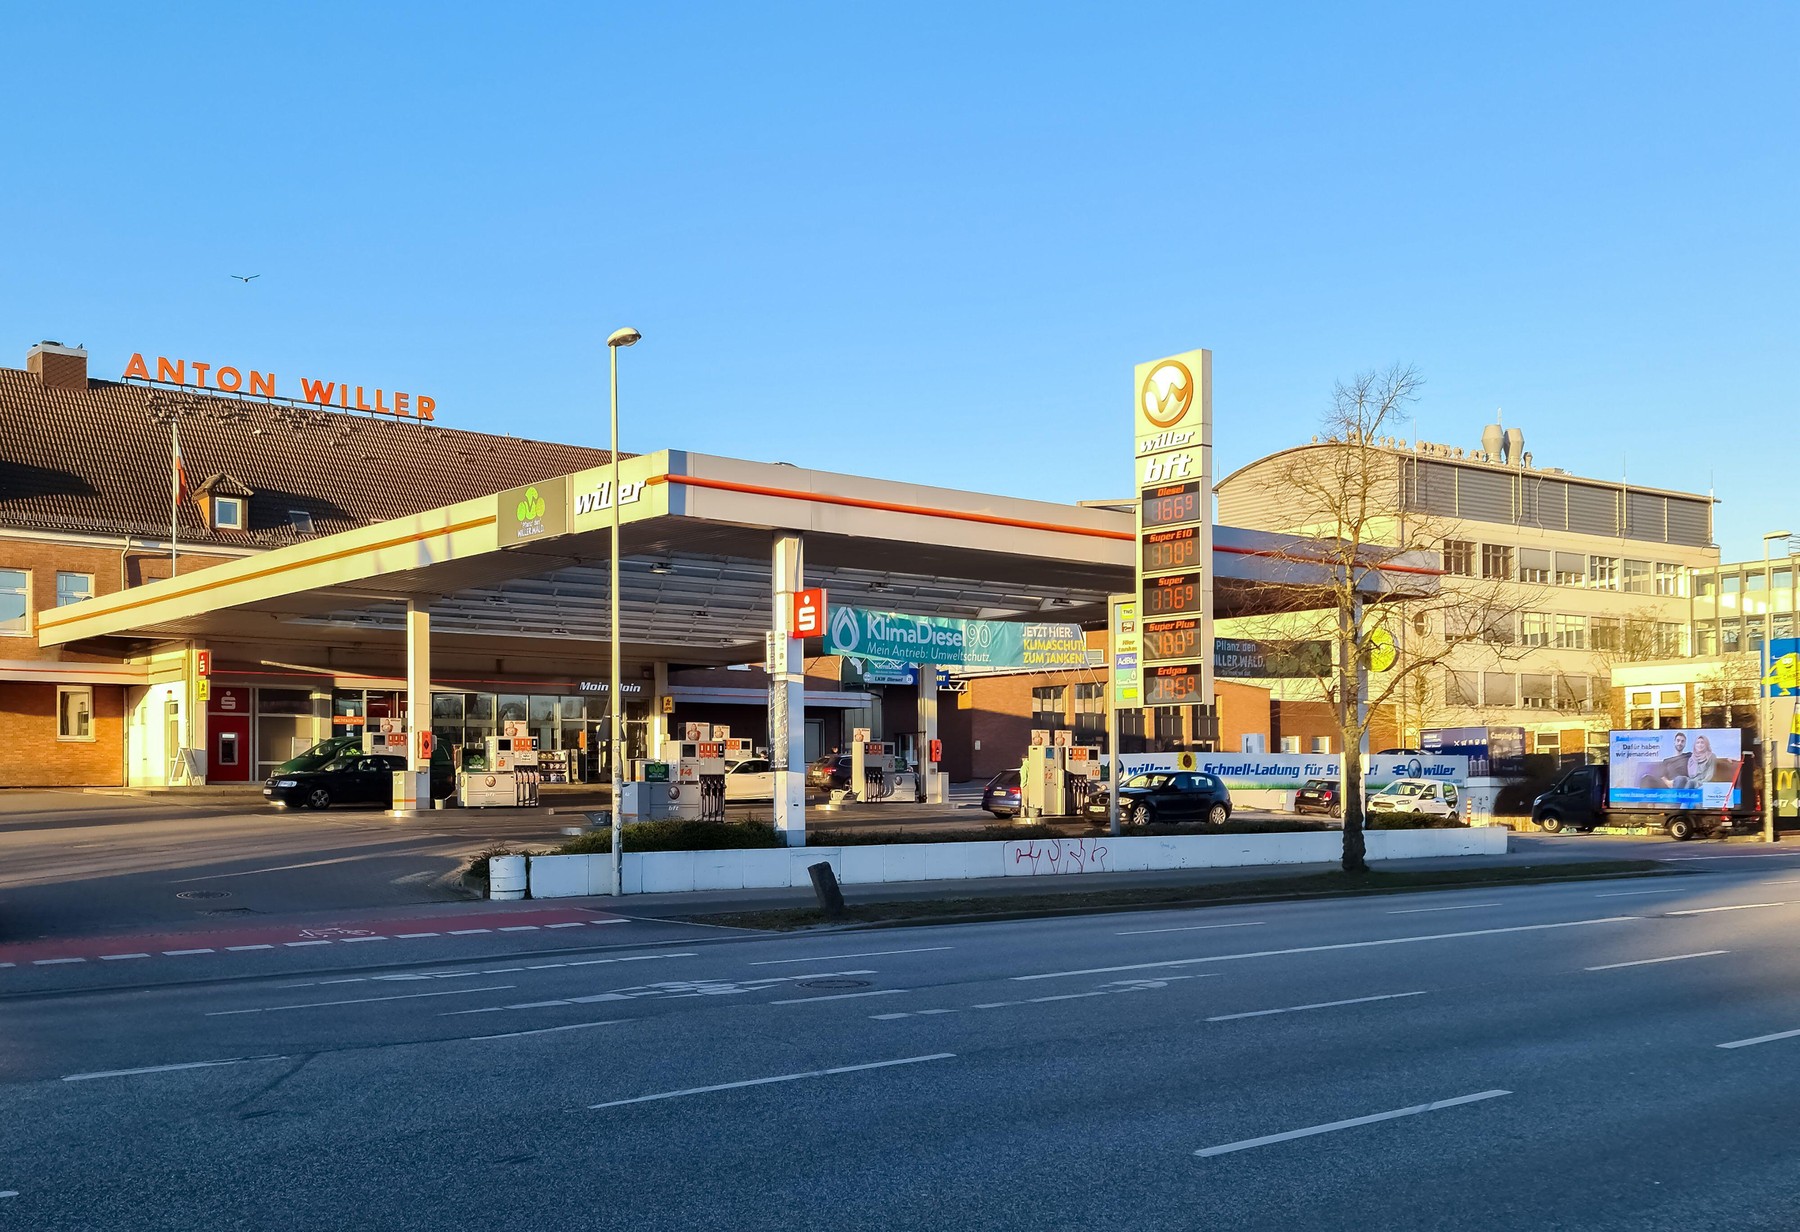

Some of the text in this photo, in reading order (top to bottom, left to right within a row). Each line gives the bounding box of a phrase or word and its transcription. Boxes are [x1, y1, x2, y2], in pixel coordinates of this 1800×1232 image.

[123, 352, 436, 421] ANTON WILLER
[1140, 431, 1195, 453] willer
[1143, 453, 1194, 484] bft
[1157, 485, 1185, 497] Diesel
[576, 481, 647, 515] wiler
[1149, 528, 1193, 543] Super E10
[1158, 577, 1185, 587] Super
[1022, 625, 1073, 639] JETZT HIER:
[1149, 620, 1195, 632] Super Plus
[866, 641, 992, 663] Mein Antrieb: Umweltschutz.
[1023, 652, 1085, 664] ZUM TANKEN!
[1213, 654, 1240, 667] ILLER
[1157, 667, 1188, 677] Erdgas
[580, 682, 609, 691] Moin
[1204, 762, 1300, 778] Schnell-Ladung
[1303, 763, 1323, 776] für
[1423, 764, 1455, 775] willer
